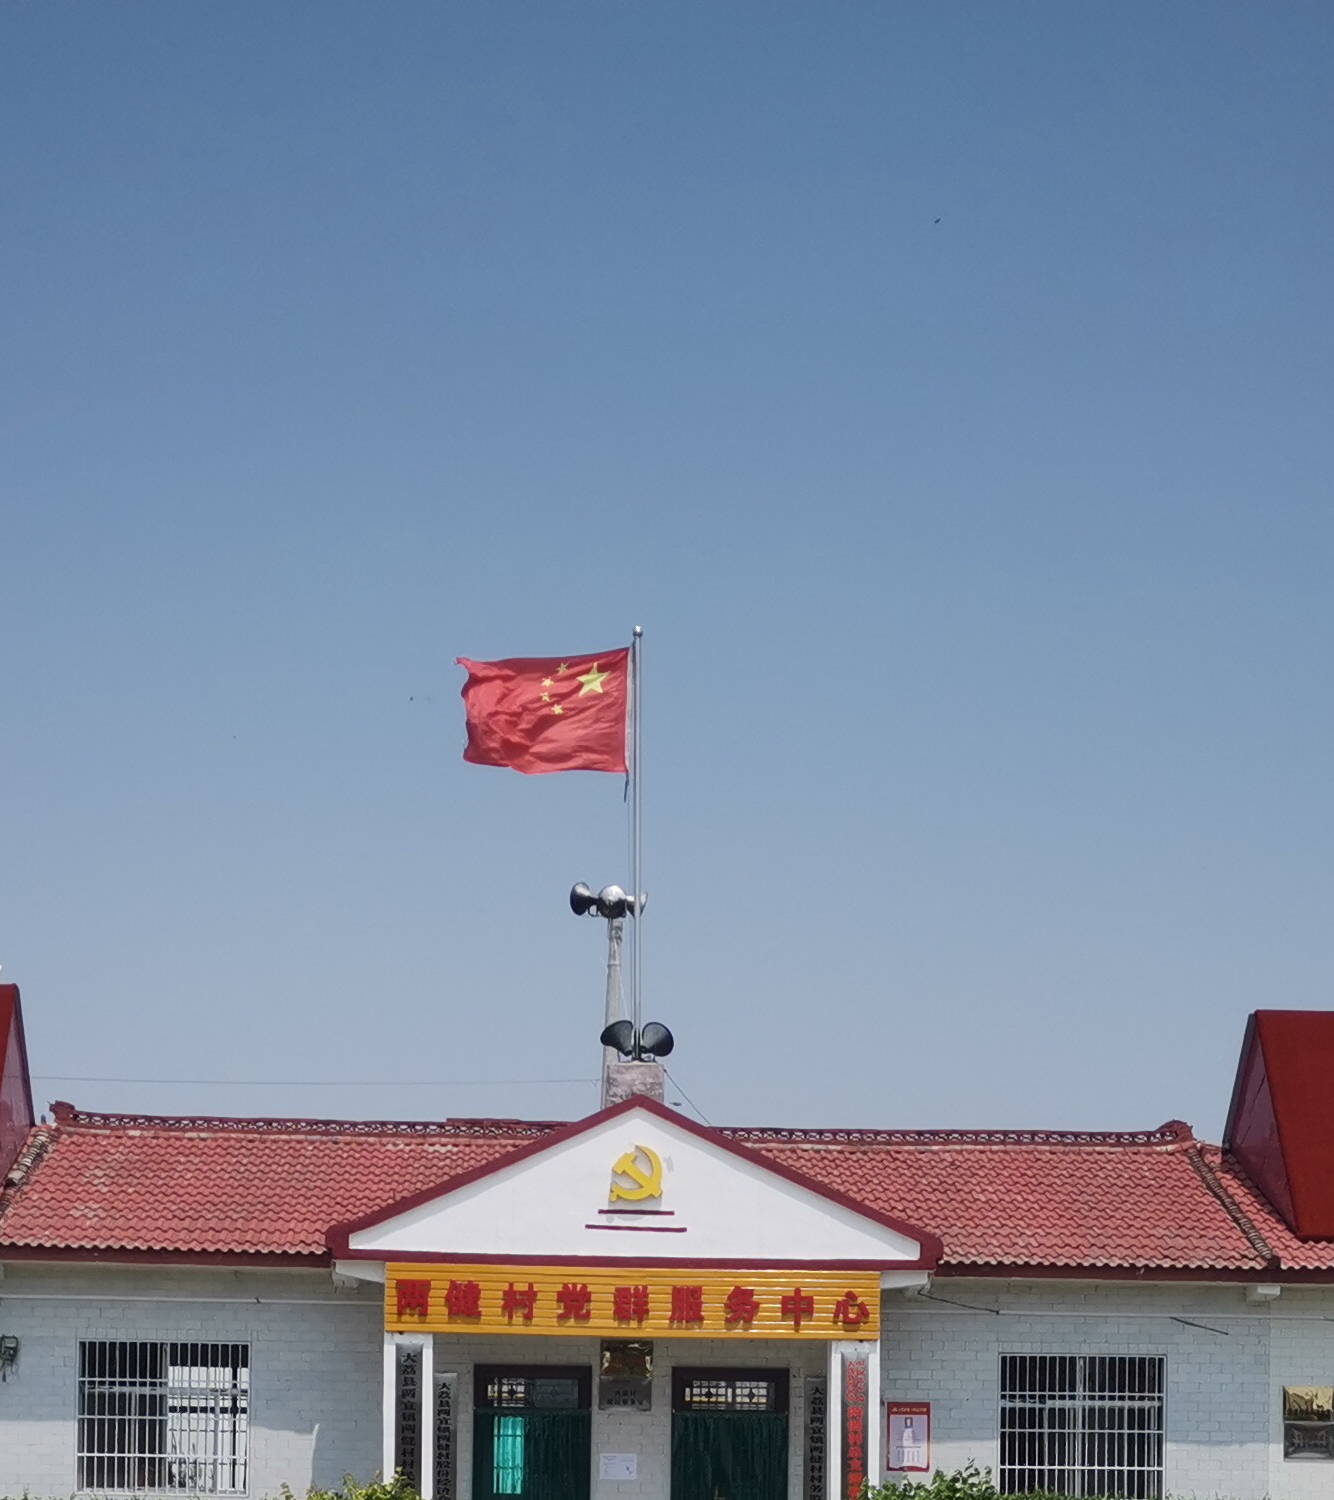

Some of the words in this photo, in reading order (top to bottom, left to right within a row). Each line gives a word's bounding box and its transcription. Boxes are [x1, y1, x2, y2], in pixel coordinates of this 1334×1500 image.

[395, 1279, 870, 1328] 两健村党群服务中心
